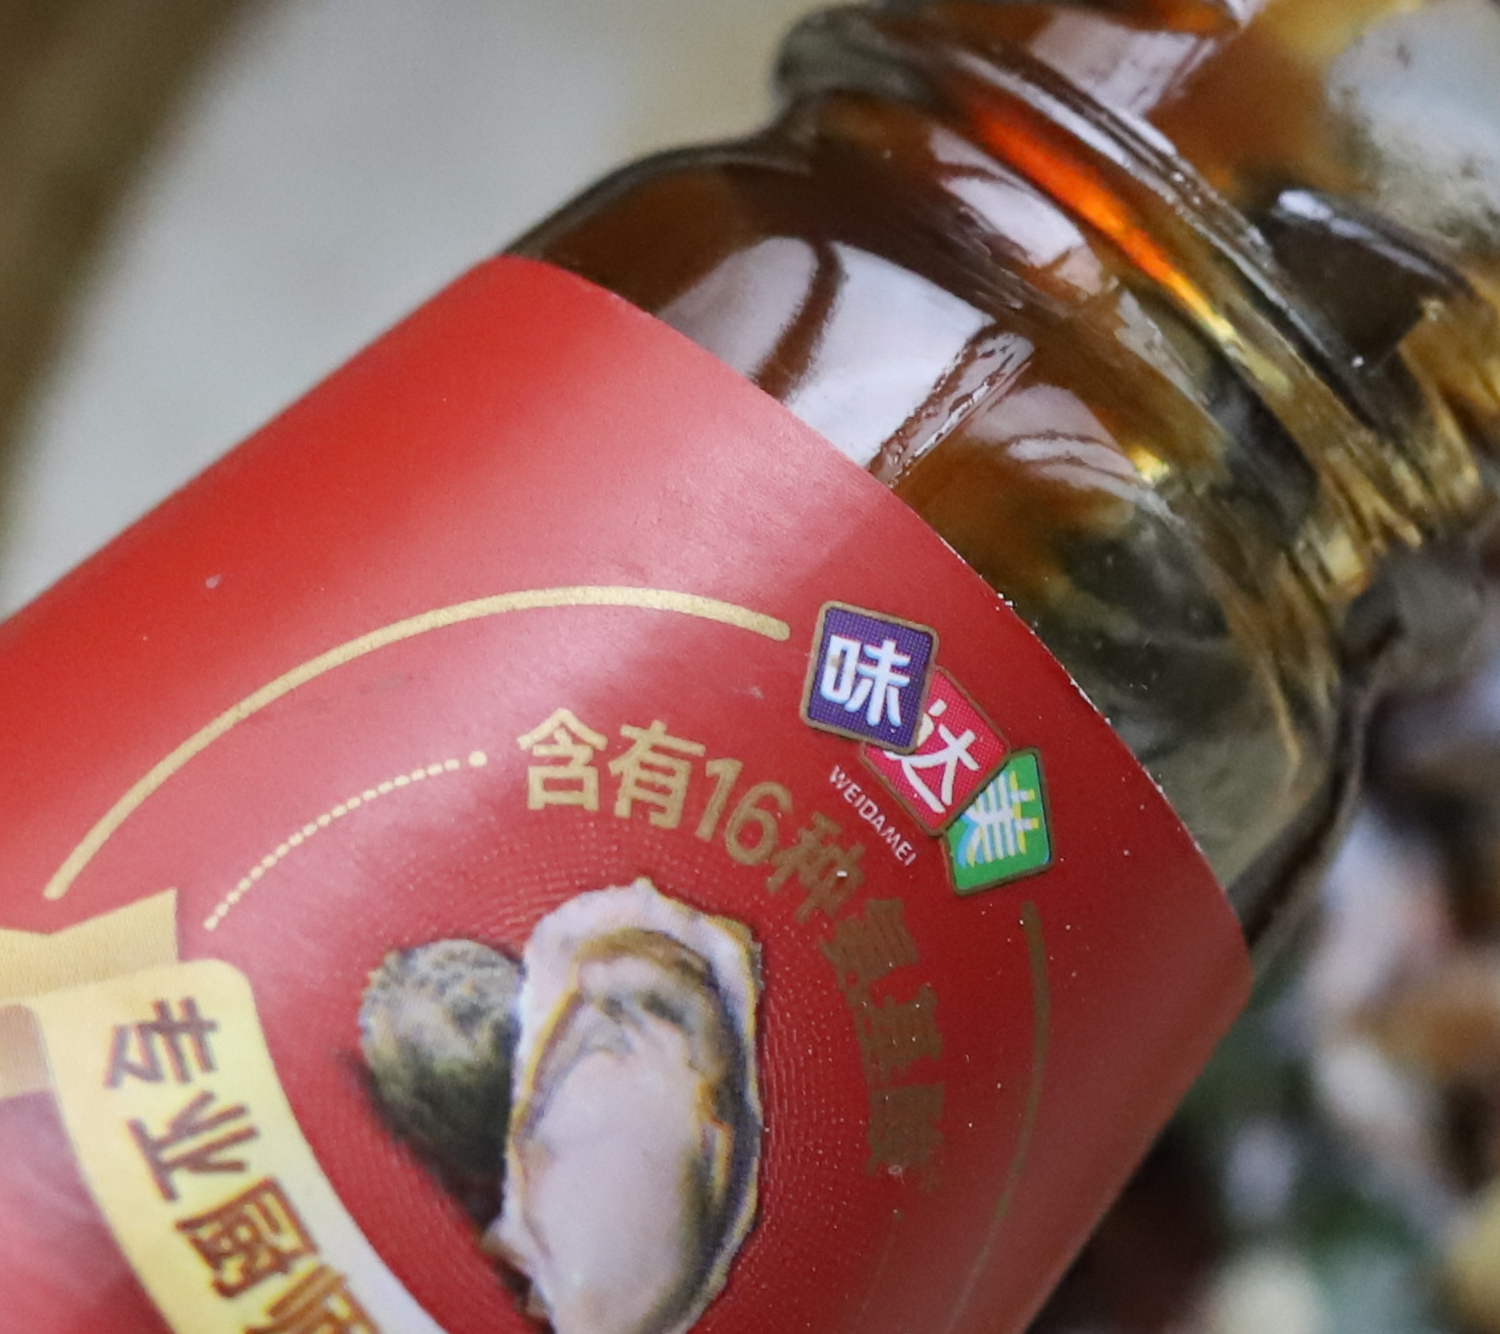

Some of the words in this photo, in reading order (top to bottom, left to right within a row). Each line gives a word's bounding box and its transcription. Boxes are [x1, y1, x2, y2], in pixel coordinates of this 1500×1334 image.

[818, 633, 1041, 870] 味达美
[828, 765, 918, 868] WEIDAMEI
[517, 707, 945, 1193] 含有16种氨基酸
